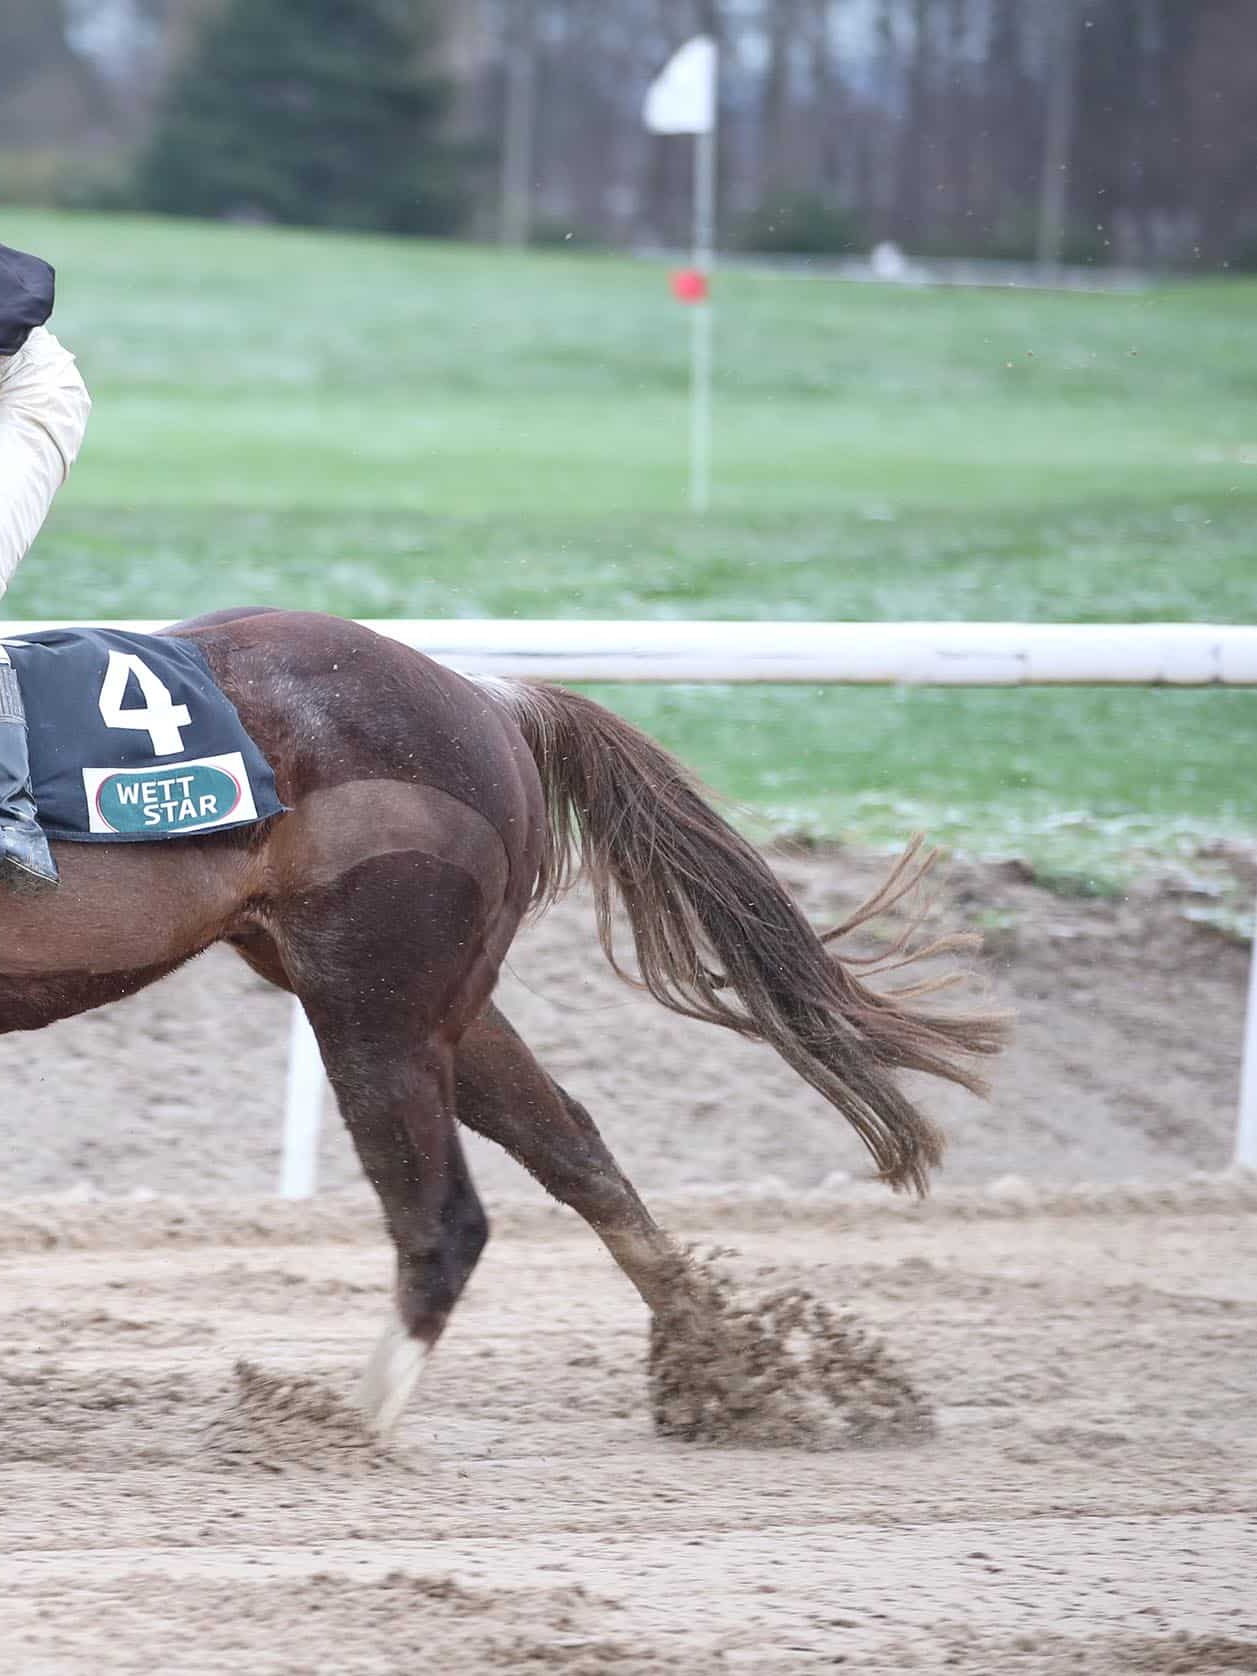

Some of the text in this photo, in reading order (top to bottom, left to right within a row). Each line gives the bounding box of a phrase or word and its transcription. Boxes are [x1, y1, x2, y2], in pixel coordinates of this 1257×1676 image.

[99, 650, 192, 756] 4
[116, 775, 195, 805] WETT
[143, 794, 218, 826] STAR
